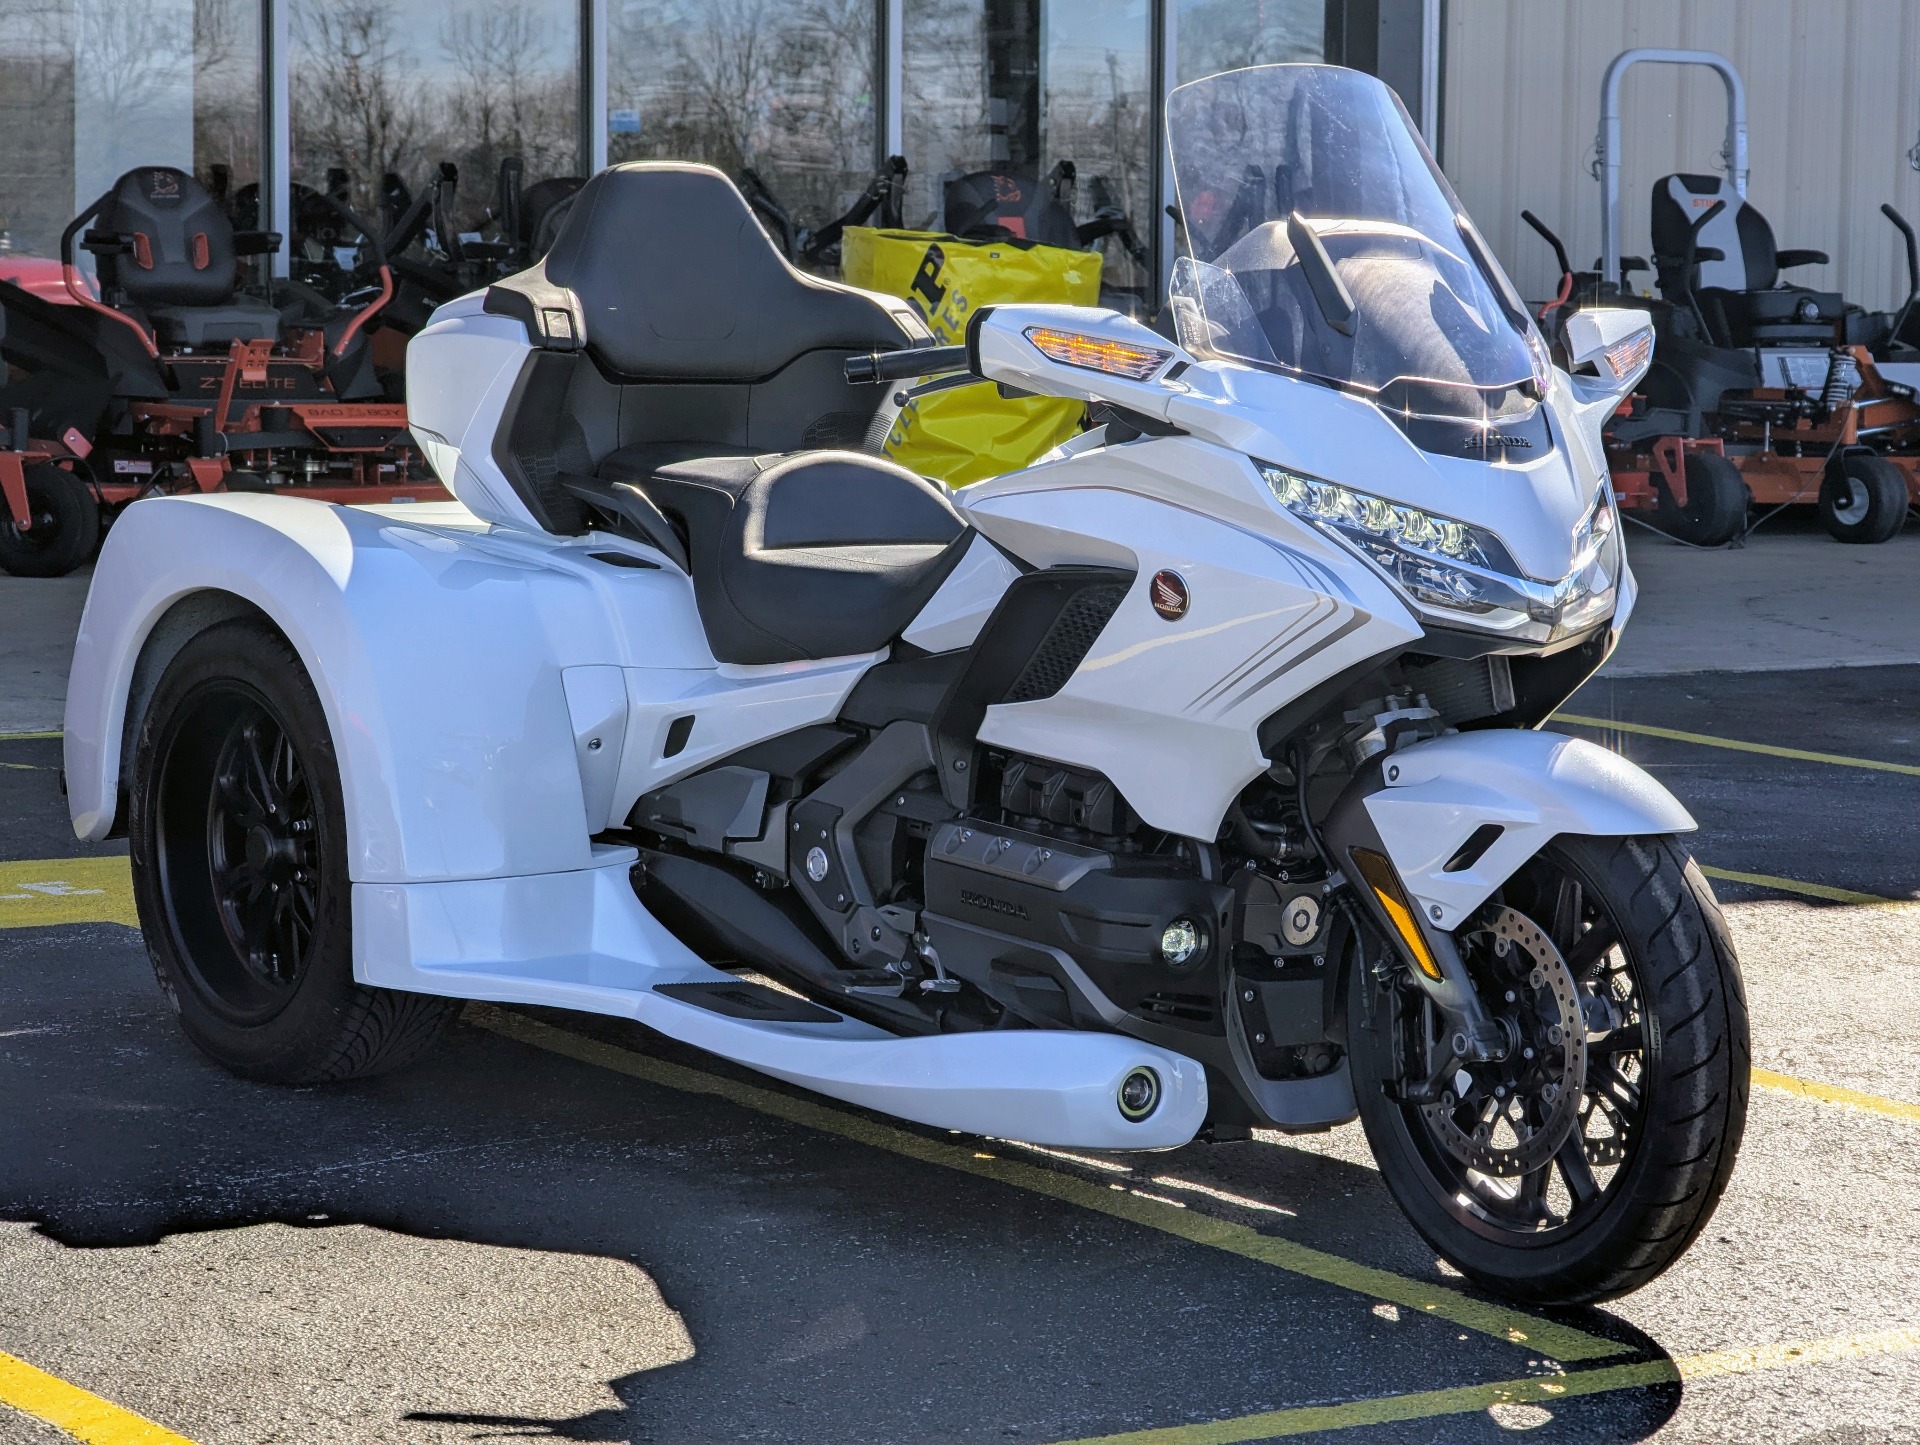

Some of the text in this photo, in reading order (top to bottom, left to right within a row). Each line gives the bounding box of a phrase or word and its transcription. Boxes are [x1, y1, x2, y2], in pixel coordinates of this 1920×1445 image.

[1692, 198, 1719, 209] STIH
[239, 377, 296, 389] ELITE
[308, 408, 401, 417] BAD BOY
[1463, 434, 1533, 450] HONDA
[1154, 602, 1184, 613] HONDA
[960, 889, 1030, 920] HONDA
